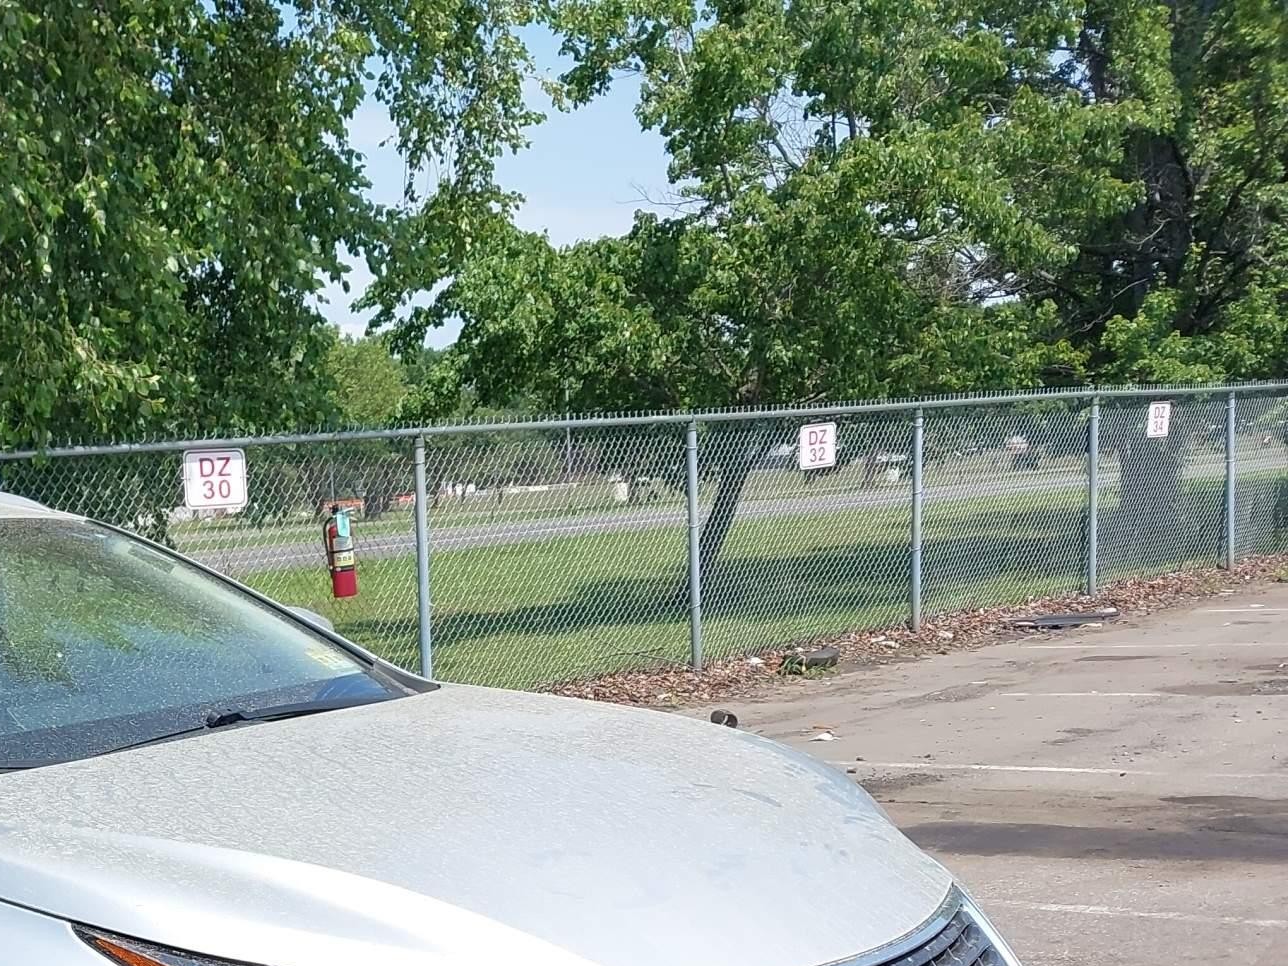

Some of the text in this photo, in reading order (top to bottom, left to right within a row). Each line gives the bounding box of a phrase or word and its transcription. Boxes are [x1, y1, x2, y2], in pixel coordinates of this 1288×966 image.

[808, 429, 828, 446] DZ
[809, 446, 827, 463] 32
[199, 457, 232, 478] DZ
[202, 480, 232, 500] 30
